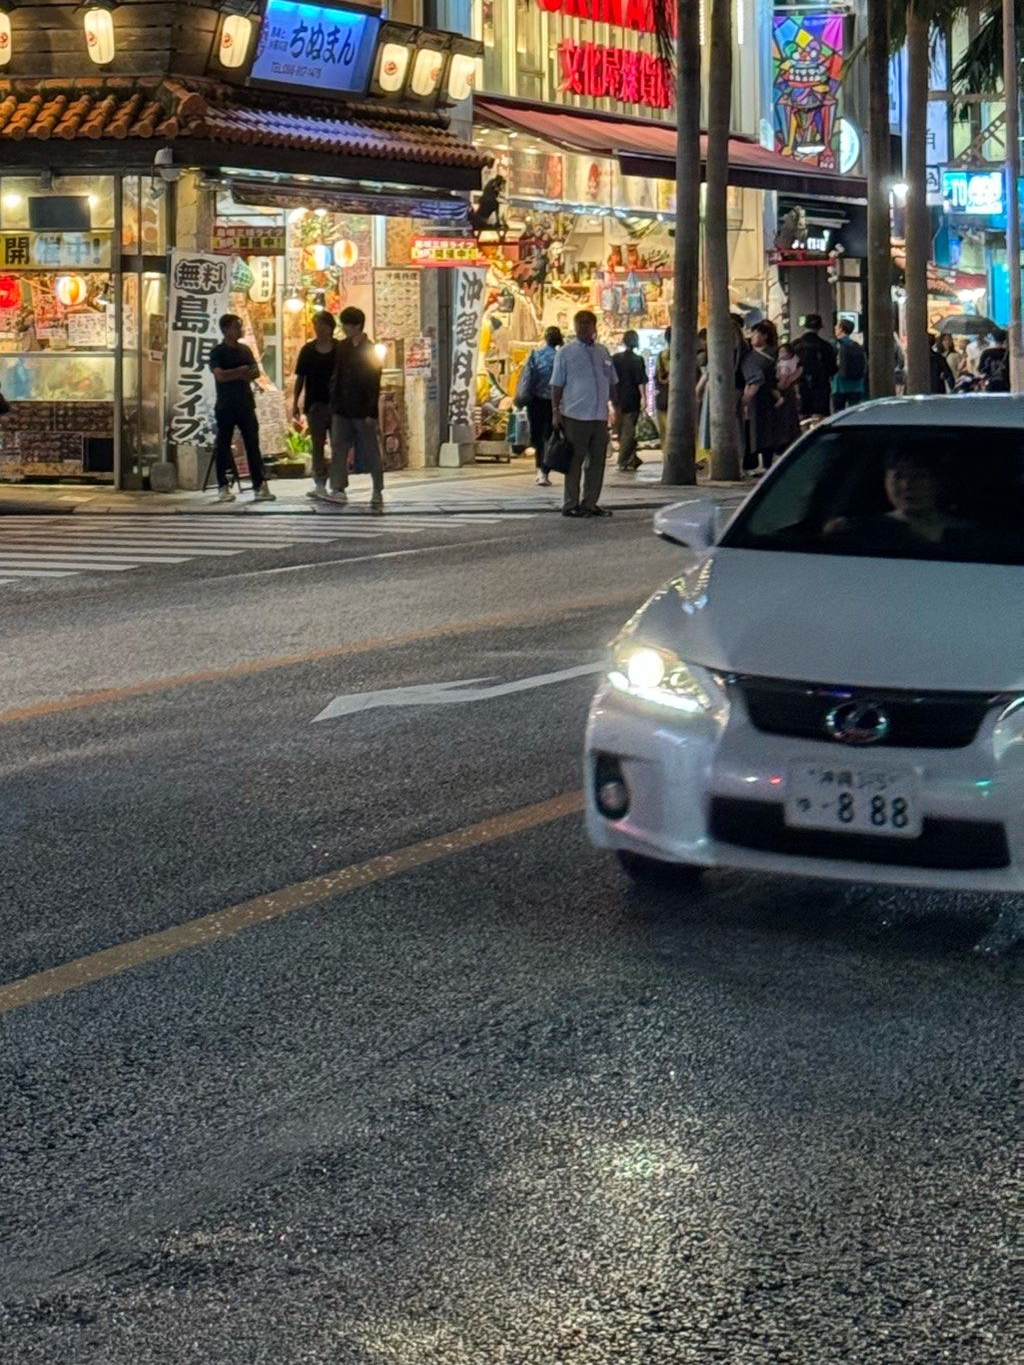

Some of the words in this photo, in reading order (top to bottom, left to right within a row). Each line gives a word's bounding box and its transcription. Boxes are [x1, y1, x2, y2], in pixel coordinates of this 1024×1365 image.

[290, 19, 356, 66] ちぬまん
[178, 263, 224, 290] 無料
